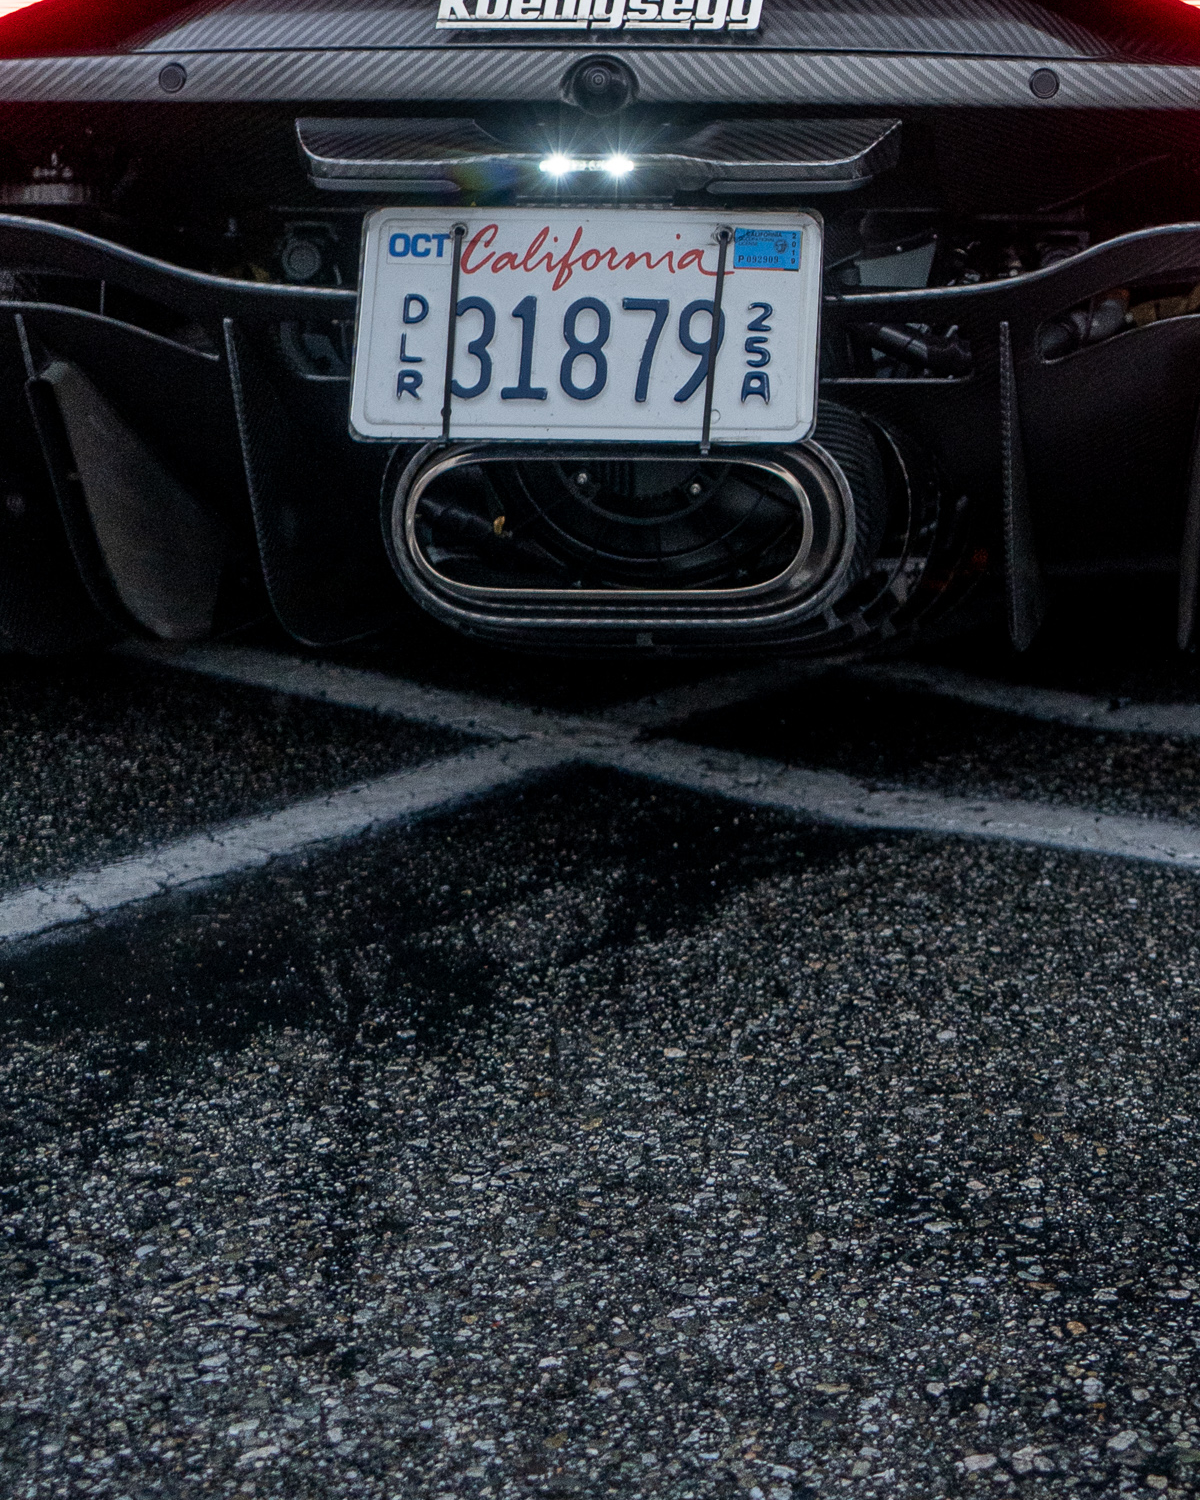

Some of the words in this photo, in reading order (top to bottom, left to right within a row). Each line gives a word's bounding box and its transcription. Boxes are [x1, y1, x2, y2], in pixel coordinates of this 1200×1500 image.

[388, 232, 451, 258] OCT
[460, 223, 735, 291] California
[738, 255, 744, 263] P
[396, 293, 429, 399] DLR
[450, 295, 726, 403] 31879
